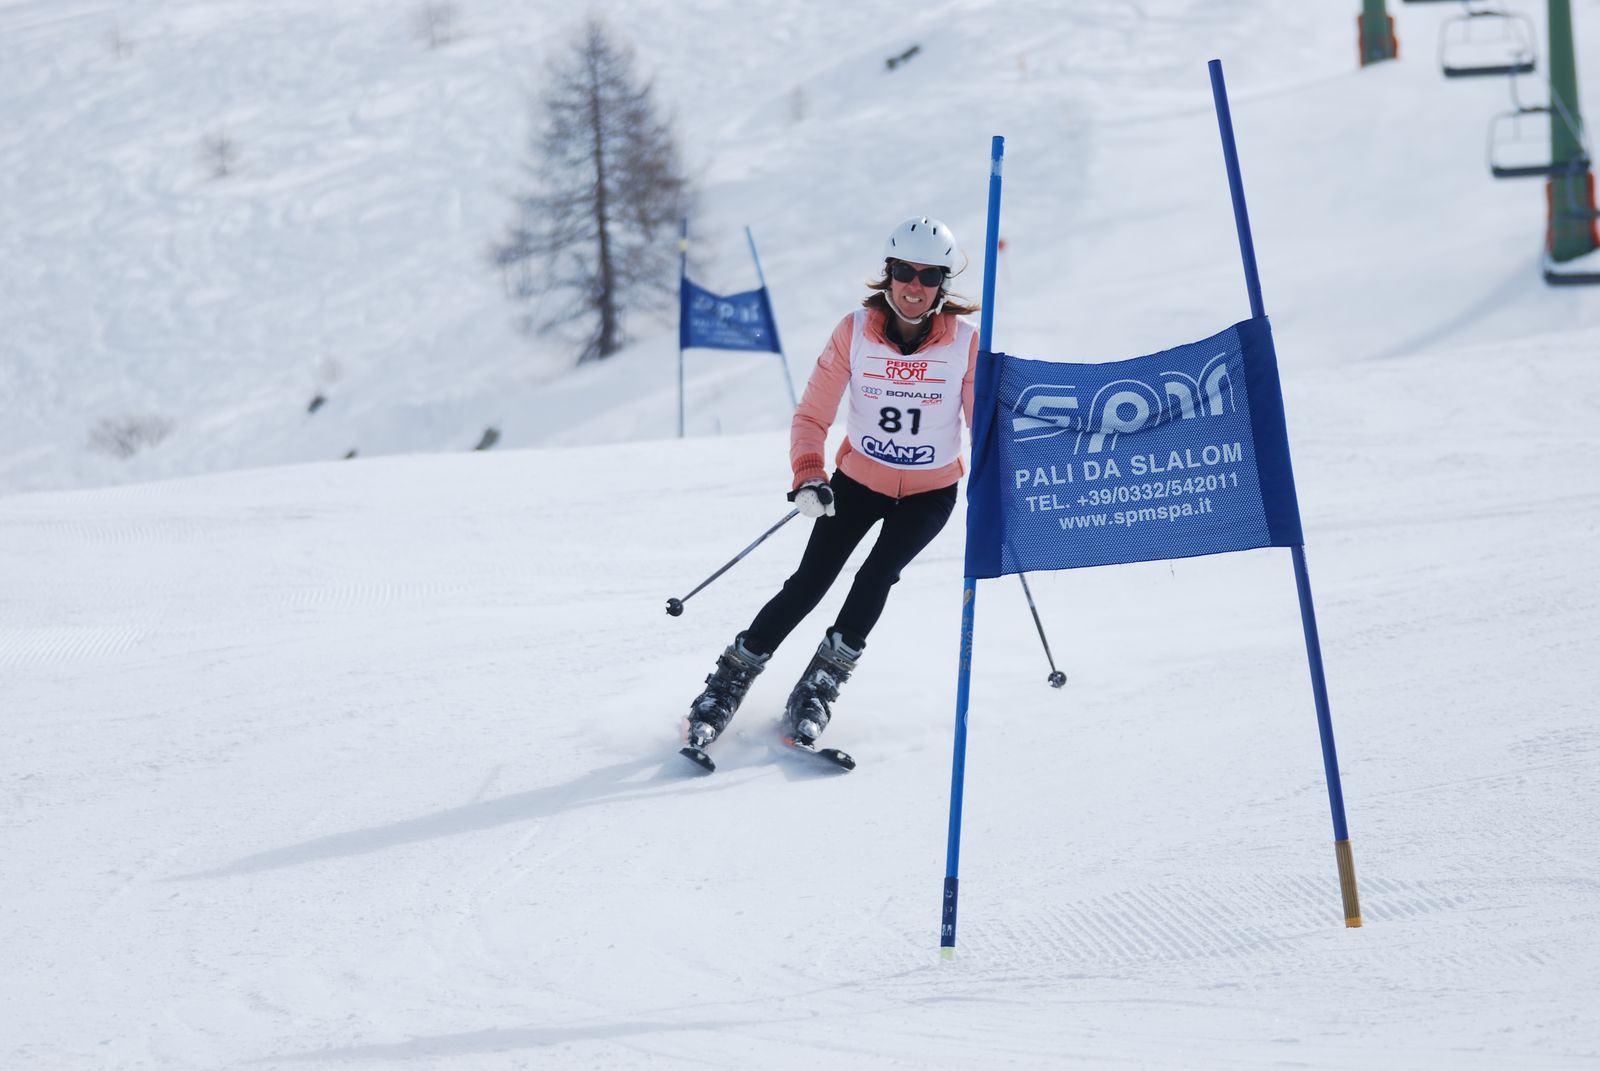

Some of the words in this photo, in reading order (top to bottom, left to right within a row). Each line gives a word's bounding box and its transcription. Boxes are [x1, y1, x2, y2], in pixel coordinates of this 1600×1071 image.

[886, 360, 928, 368] PERICO
[886, 366, 927, 380] SPORT
[886, 390, 942, 399] BONALDI
[878, 406, 921, 435] 81
[1015, 465, 1074, 489] PALI
[1083, 459, 1122, 482] DA
[1130, 442, 1243, 476] SLALOM
[1025, 492, 1071, 513] TEL.
[1077, 471, 1238, 506] +39/0332/542011
[1058, 497, 1213, 530] www.spmspa.it
